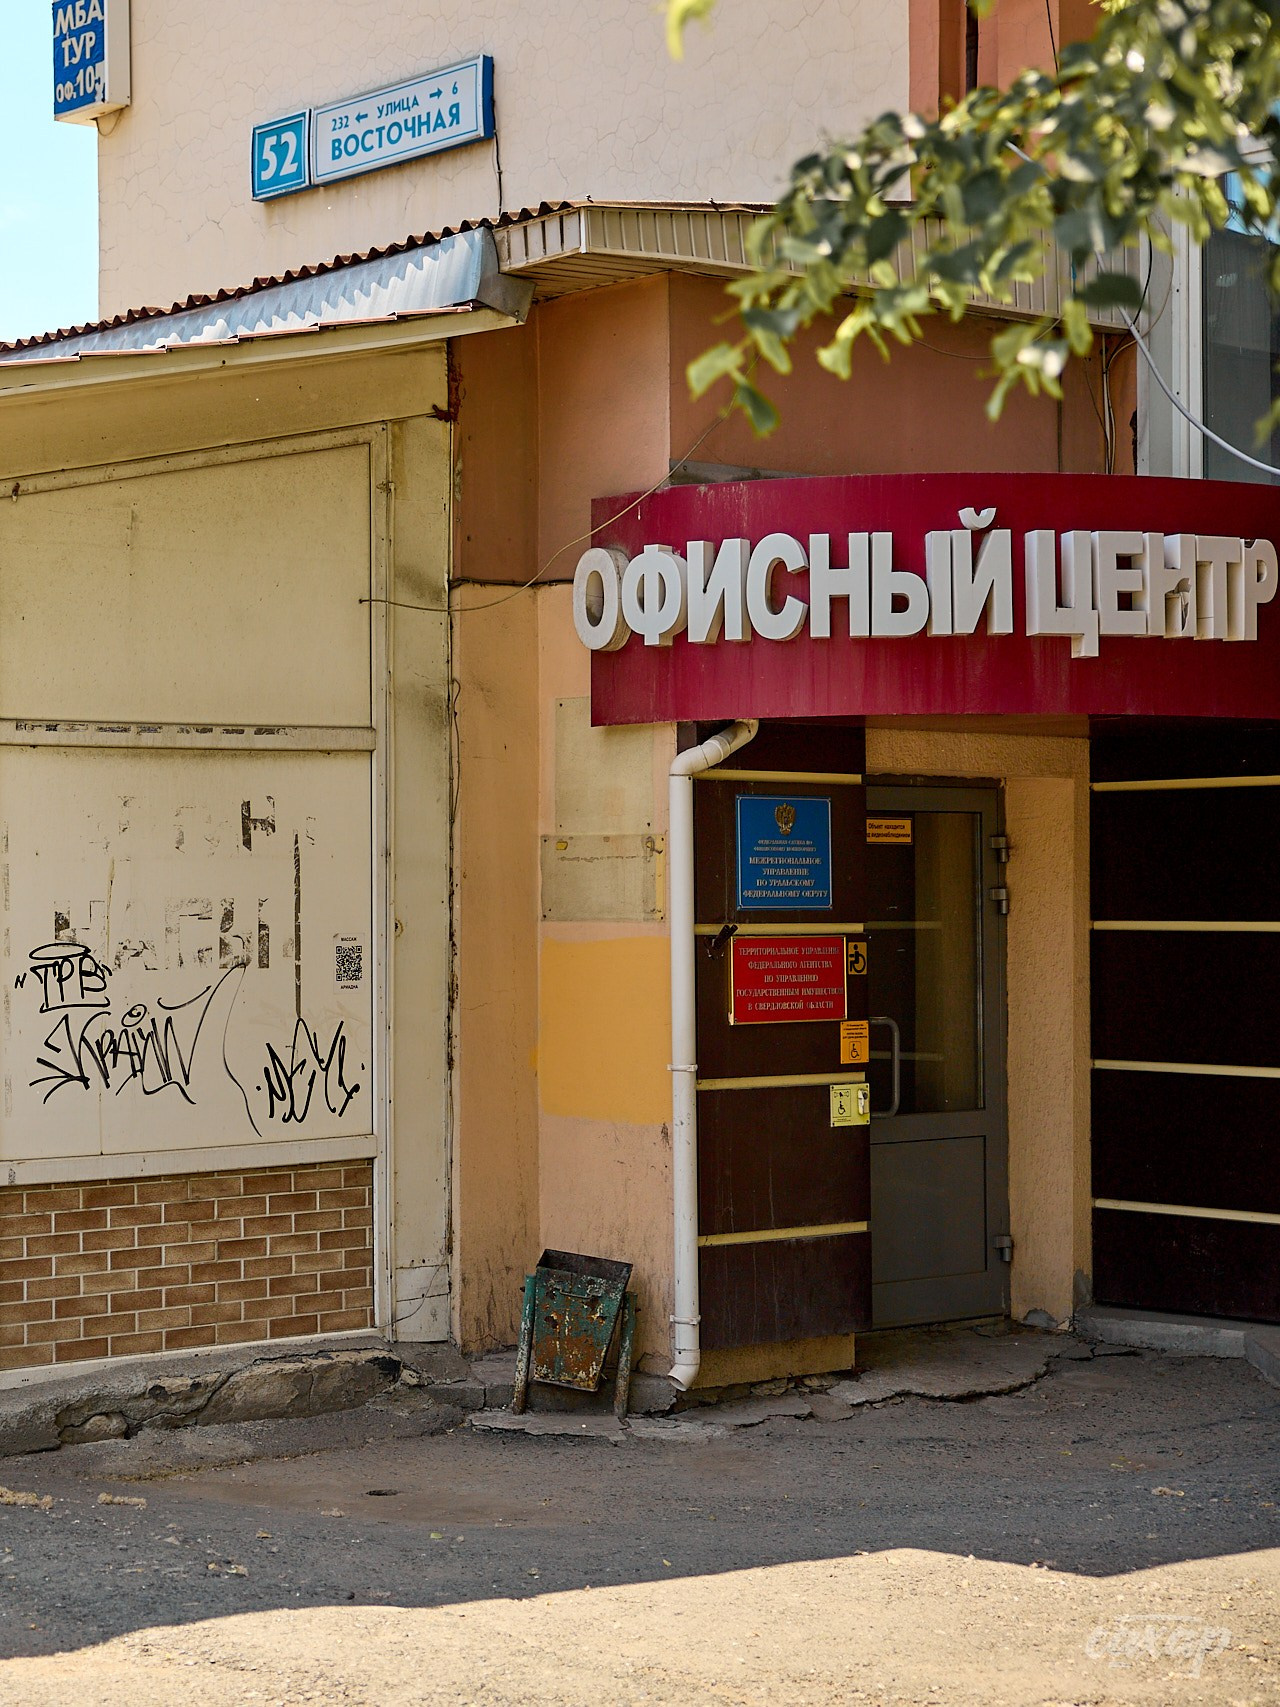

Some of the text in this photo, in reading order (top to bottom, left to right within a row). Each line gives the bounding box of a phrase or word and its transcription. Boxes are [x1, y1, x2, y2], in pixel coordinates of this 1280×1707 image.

[62, 31, 96, 67] ТУР
[331, 81, 458, 131] 232 УЛИЦА 6
[331, 102, 461, 161] ВОСТОЧНАЯ
[261, 131, 299, 181] 52
[572, 507, 1278, 659] ОФИСНЫЙ ЦЕНТР
[749, 857, 822, 865] МЕЖРЕГИОНАЛЬНОЕ
[763, 868, 809, 876] УПРАВЛЕНИЕ
[756, 879, 815, 887] ПО УРАЛЬСКОМУ
[743, 890, 828, 898] ФЕДЕРАЛЬНОМУ ОКРУГУ
[739, 947, 799, 956] ТЕРРИТОРИАЛЬНОЕ
[748, 960, 832, 970] ФЕДЕРАЛЬНОГО АГЕНТСТВА
[764, 974, 818, 983] ПО УПРАВЛЕНИЮ
[736, 988, 799, 998] ГОСУДАРСТВЕННЫМ
[755, 1000, 803, 1010] СВЕРДЛОВСКОЙ
[806, 1001, 834, 1009] ОБЛАСТИ
